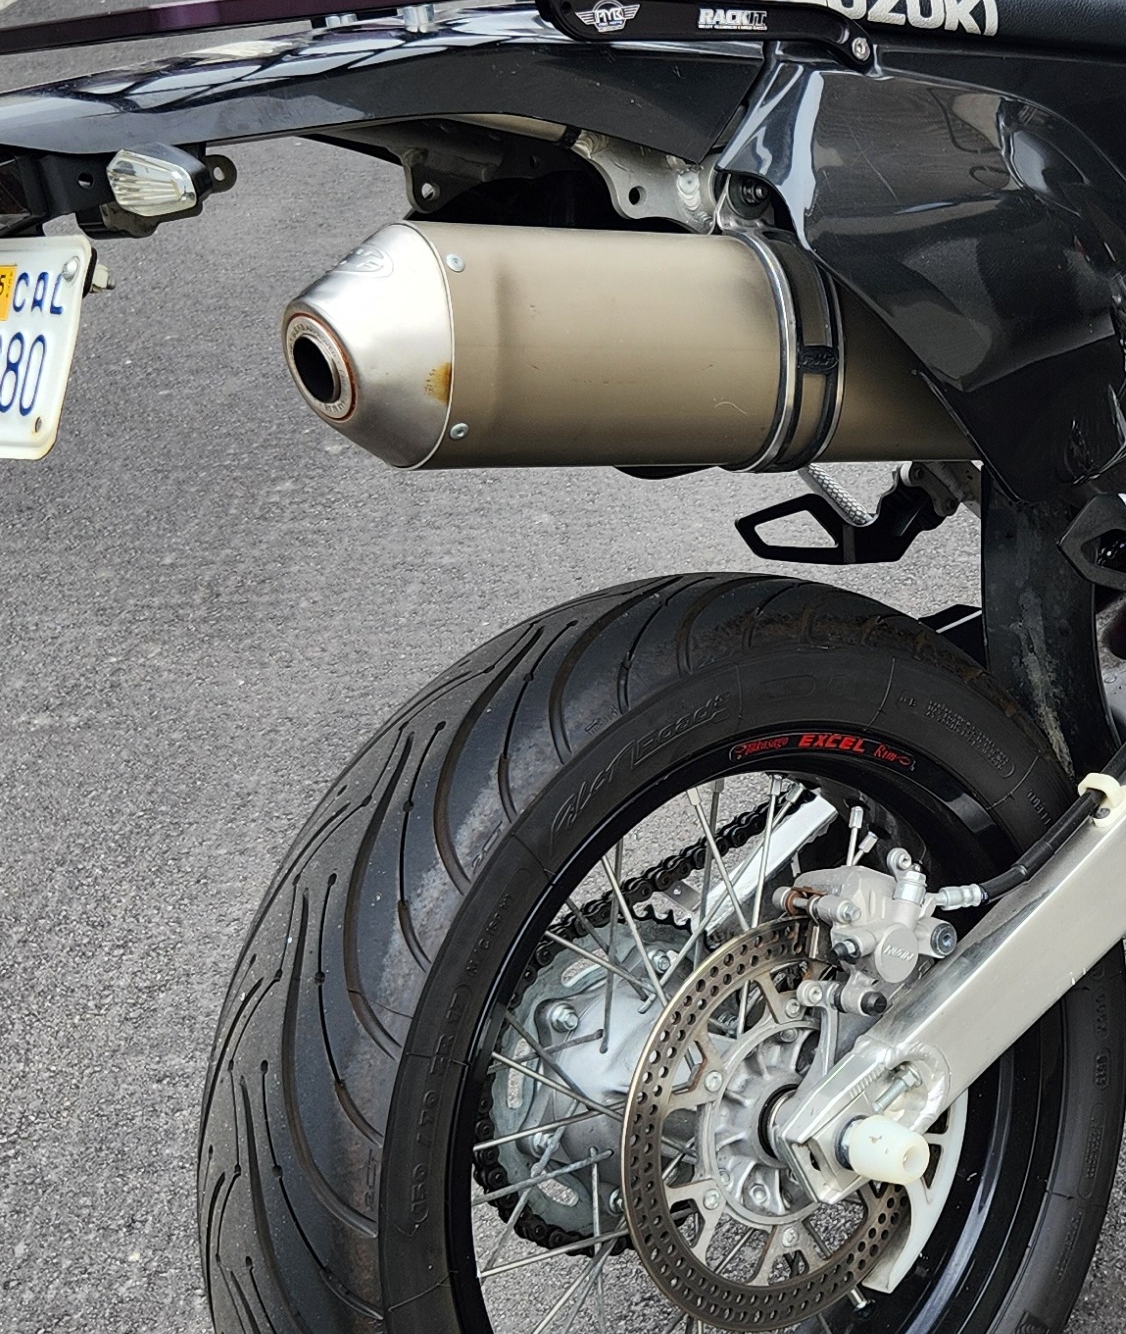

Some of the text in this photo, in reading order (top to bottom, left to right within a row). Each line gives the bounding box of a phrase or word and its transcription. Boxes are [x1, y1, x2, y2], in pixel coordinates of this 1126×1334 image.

[13, 272, 64, 315] CAL
[0, 331, 47, 417] 80
[798, 732, 866, 755] EXCEL
